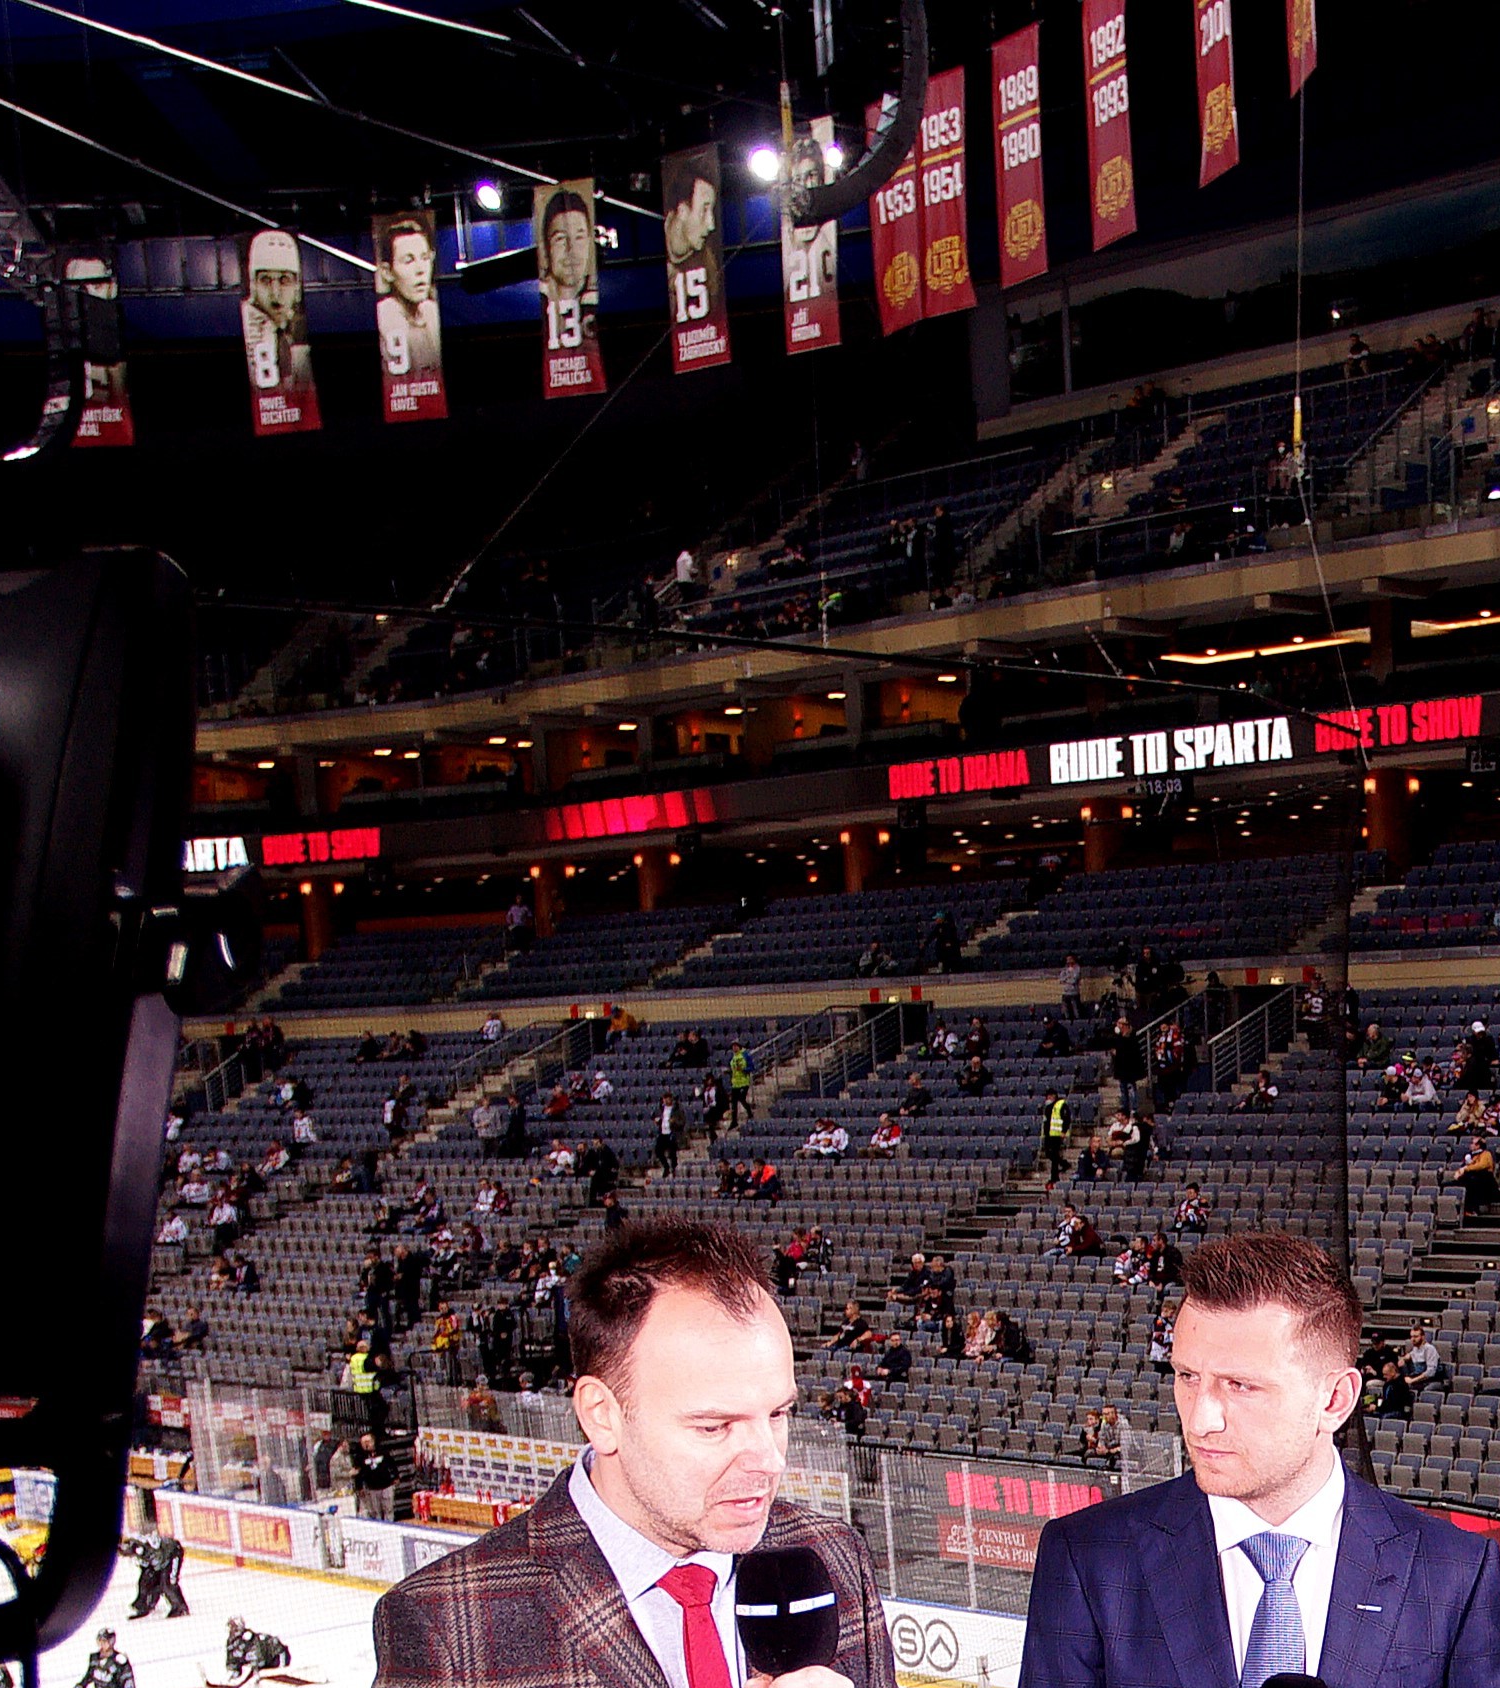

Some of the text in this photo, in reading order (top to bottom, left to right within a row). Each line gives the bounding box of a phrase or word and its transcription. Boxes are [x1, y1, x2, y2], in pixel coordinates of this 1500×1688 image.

[1090, 14, 1126, 68] 1992
[999, 65, 1038, 114] 1989
[1093, 75, 1128, 127] 1993
[921, 107, 961, 152] 1953
[1002, 123, 1040, 170] 1990
[875, 179, 916, 224] 1953
[923, 162, 963, 207] 1954
[674, 268, 709, 323] 15
[789, 248, 821, 303] 21
[547, 300, 582, 349] 13
[257, 344, 280, 388] 8
[387, 333, 411, 374] 9
[1376, 703, 1408, 747] TO
[1410, 695, 1483, 743] SHOW
[889, 748, 1031, 800] BUDE TO DRAMA
[1049, 716, 1294, 785] BUDE TO SPARTA
